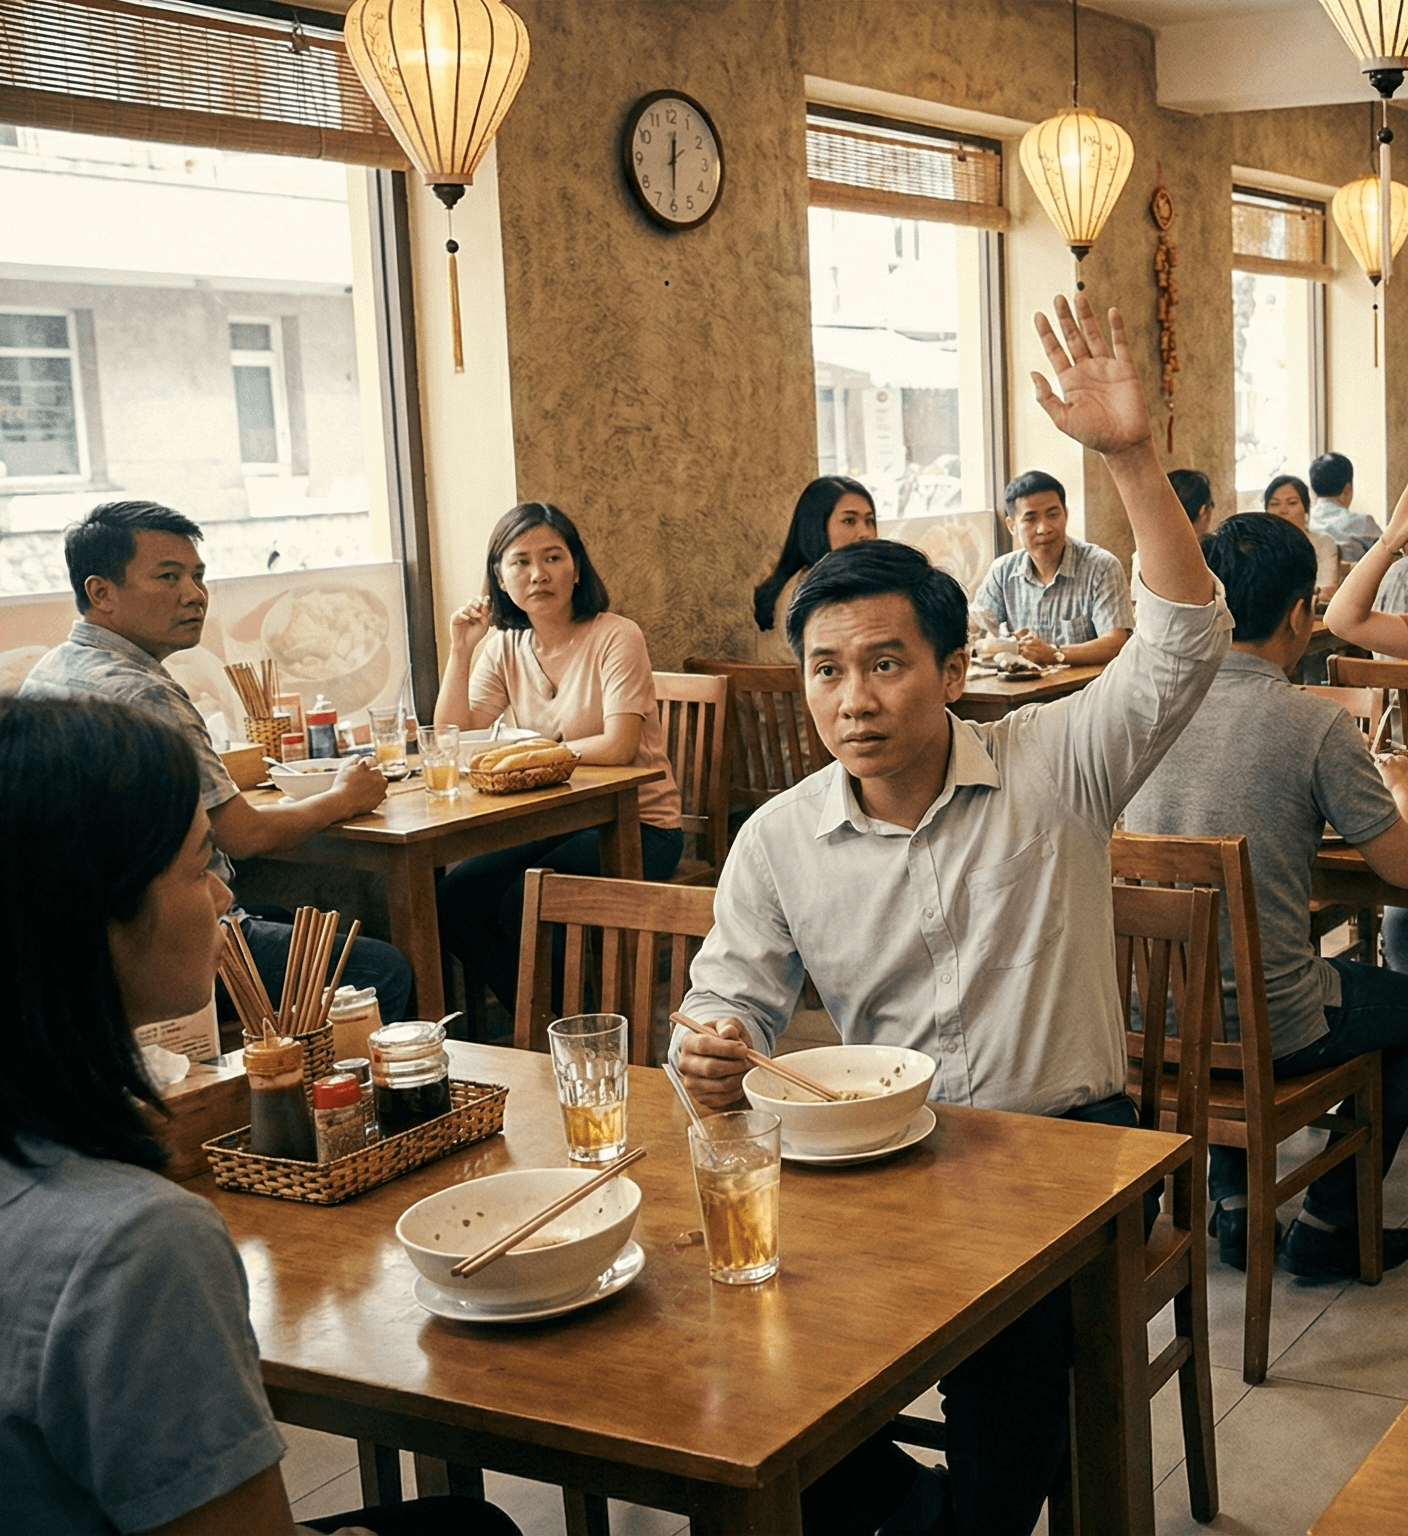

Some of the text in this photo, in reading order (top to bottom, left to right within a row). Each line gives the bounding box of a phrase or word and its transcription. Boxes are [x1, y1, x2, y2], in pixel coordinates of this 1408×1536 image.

[650, 112, 660, 128] 11
[666, 109, 677, 125] 12
[638, 127, 652, 145] 10
[695, 135, 703, 150] 2
[635, 151, 643, 166] 9
[701, 158, 709, 173] 3
[642, 174, 650, 189] 8
[697, 180, 705, 193] 4
[654, 191, 662, 207] 7
[670, 198, 678, 213] 6
[686, 195, 694, 210] 5
